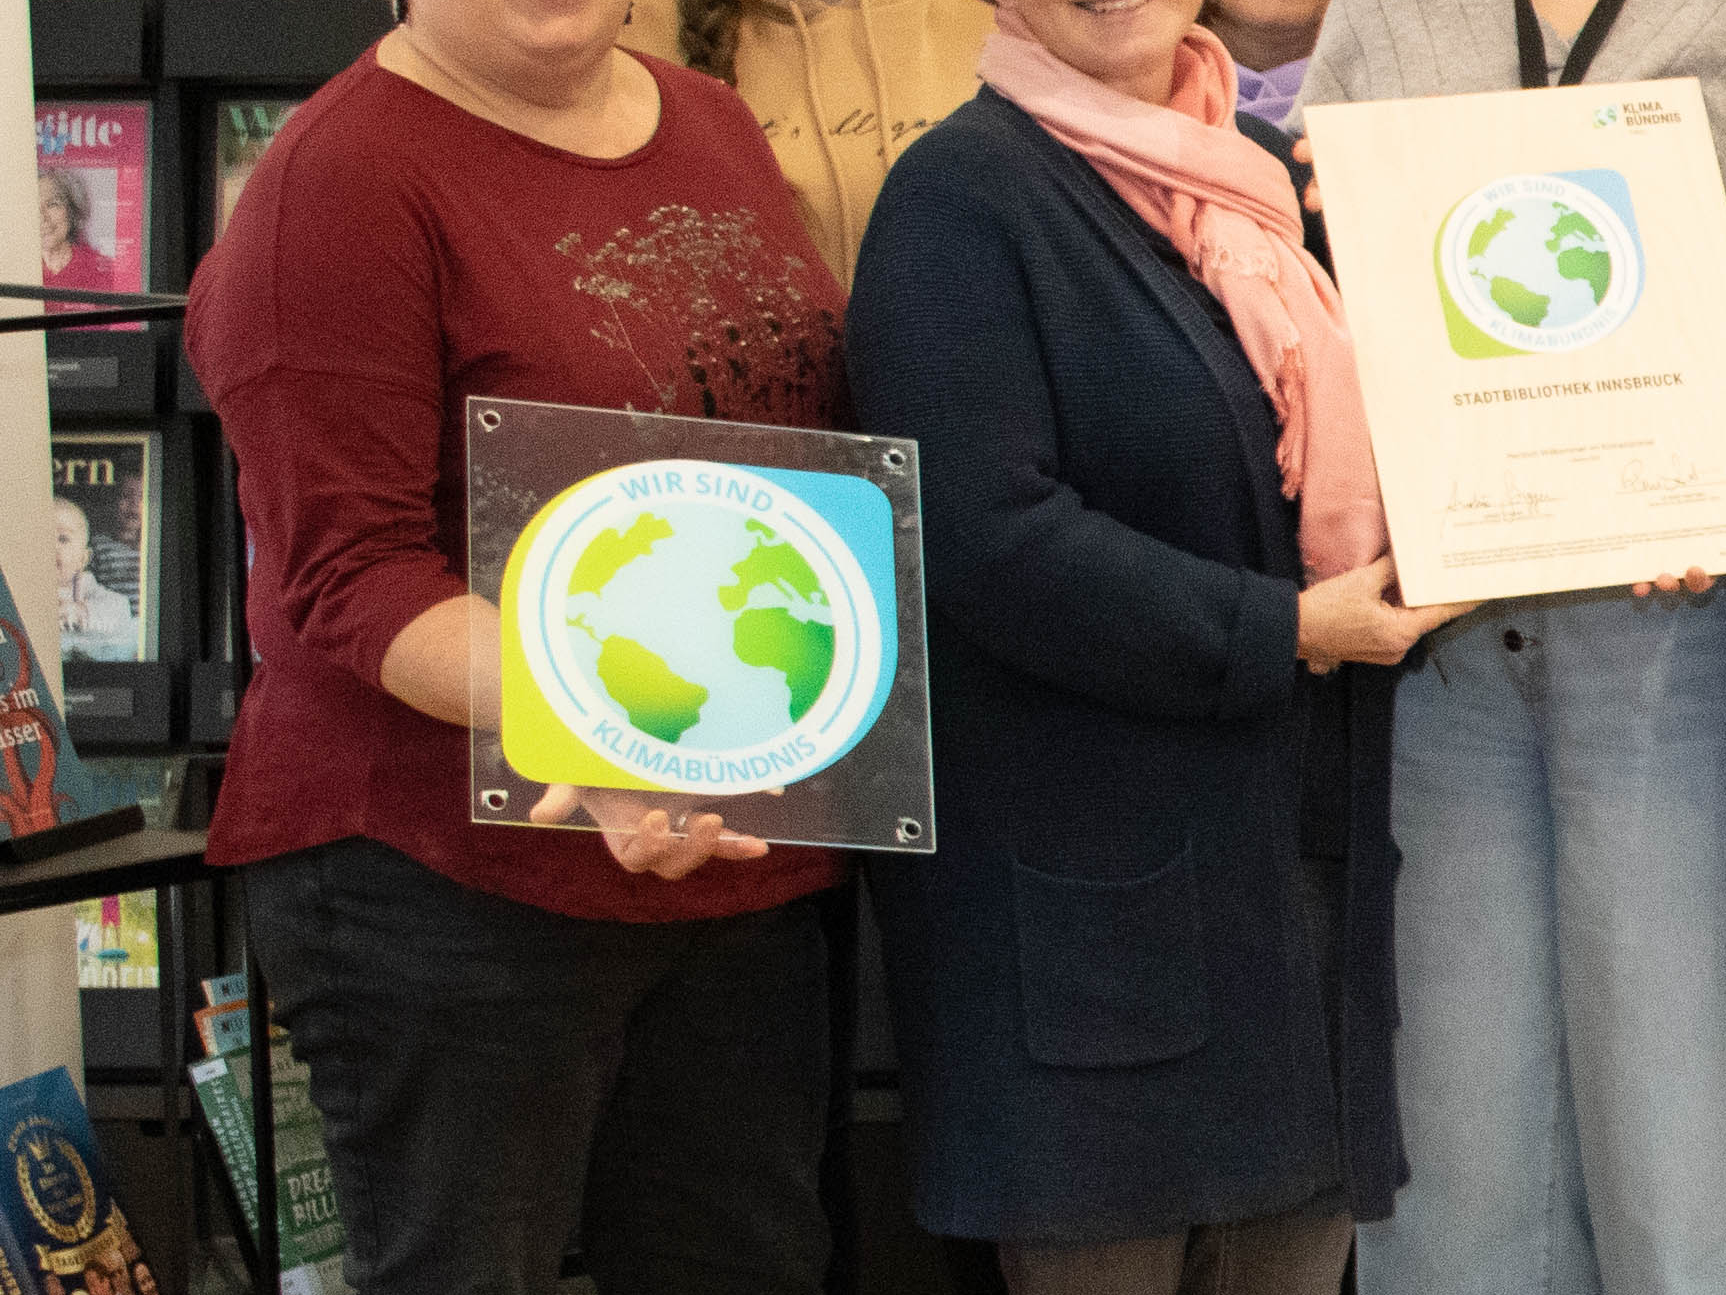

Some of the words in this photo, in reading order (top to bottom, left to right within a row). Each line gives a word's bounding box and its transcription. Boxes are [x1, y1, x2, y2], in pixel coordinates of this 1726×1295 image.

[1622, 101, 1664, 114] KLIMA
[1625, 112, 1683, 126] BÜNDNIS
[1483, 182, 1517, 203] WIR
[1522, 179, 1566, 198] SIND
[1453, 382, 1593, 406] STADTBIBLIOTHEK
[1597, 372, 1684, 392] INNSBRUCK
[618, 472, 684, 503] WIR
[696, 472, 773, 513] SIND
[10, 682, 40, 709] im
[0, 721, 41, 748] sser
[592, 718, 818, 785] KLIMABÜNDNIS
